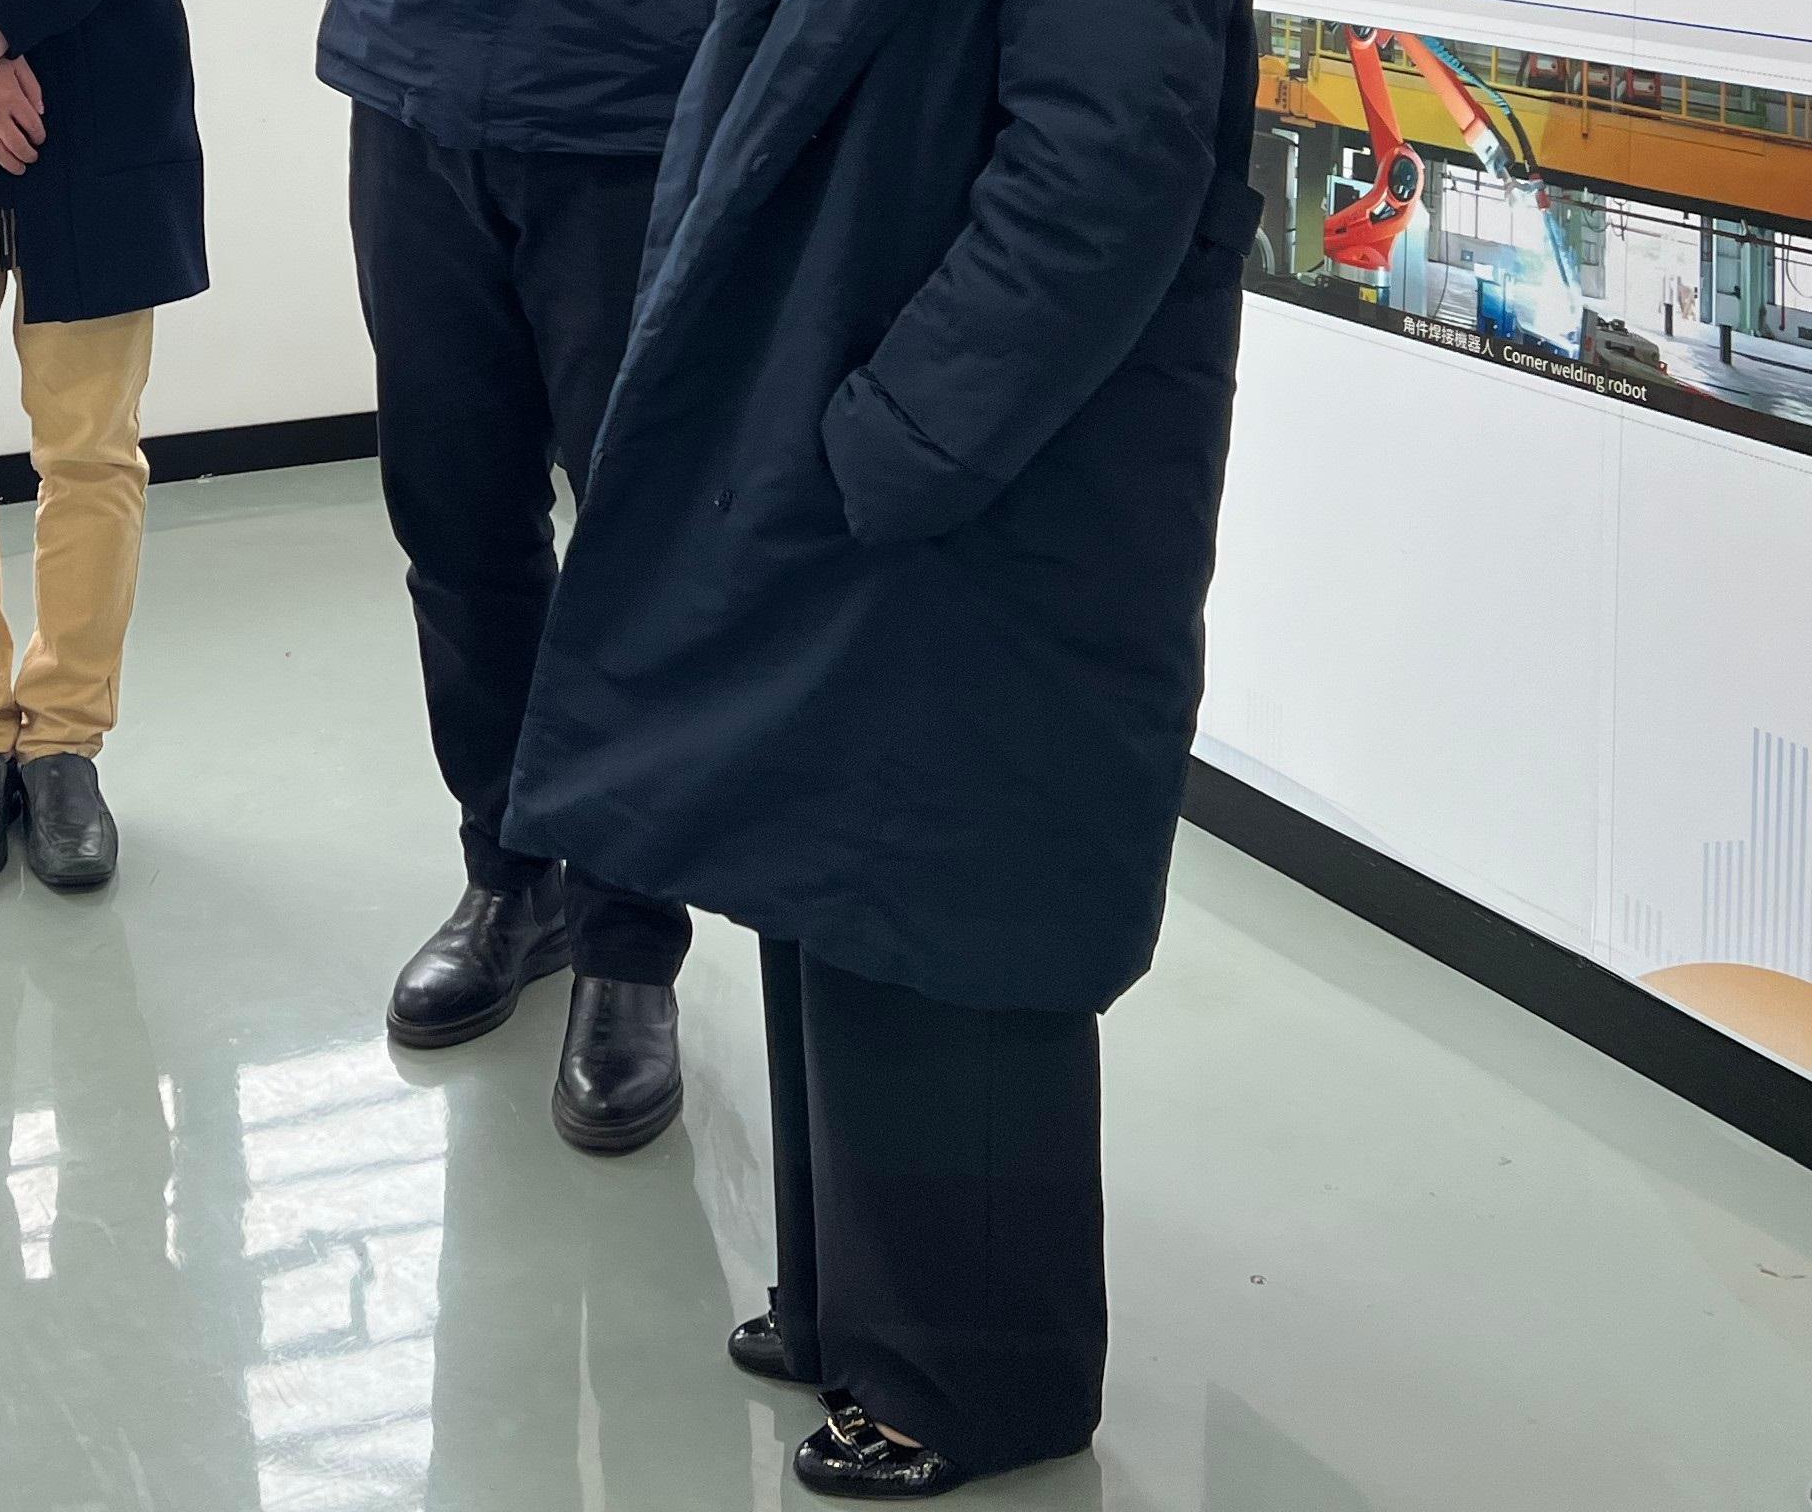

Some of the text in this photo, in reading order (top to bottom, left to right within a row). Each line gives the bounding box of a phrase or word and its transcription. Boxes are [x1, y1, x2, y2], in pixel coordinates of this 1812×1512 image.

[1403, 316, 1648, 402] 角件焊接機器人 Corner welding robot
